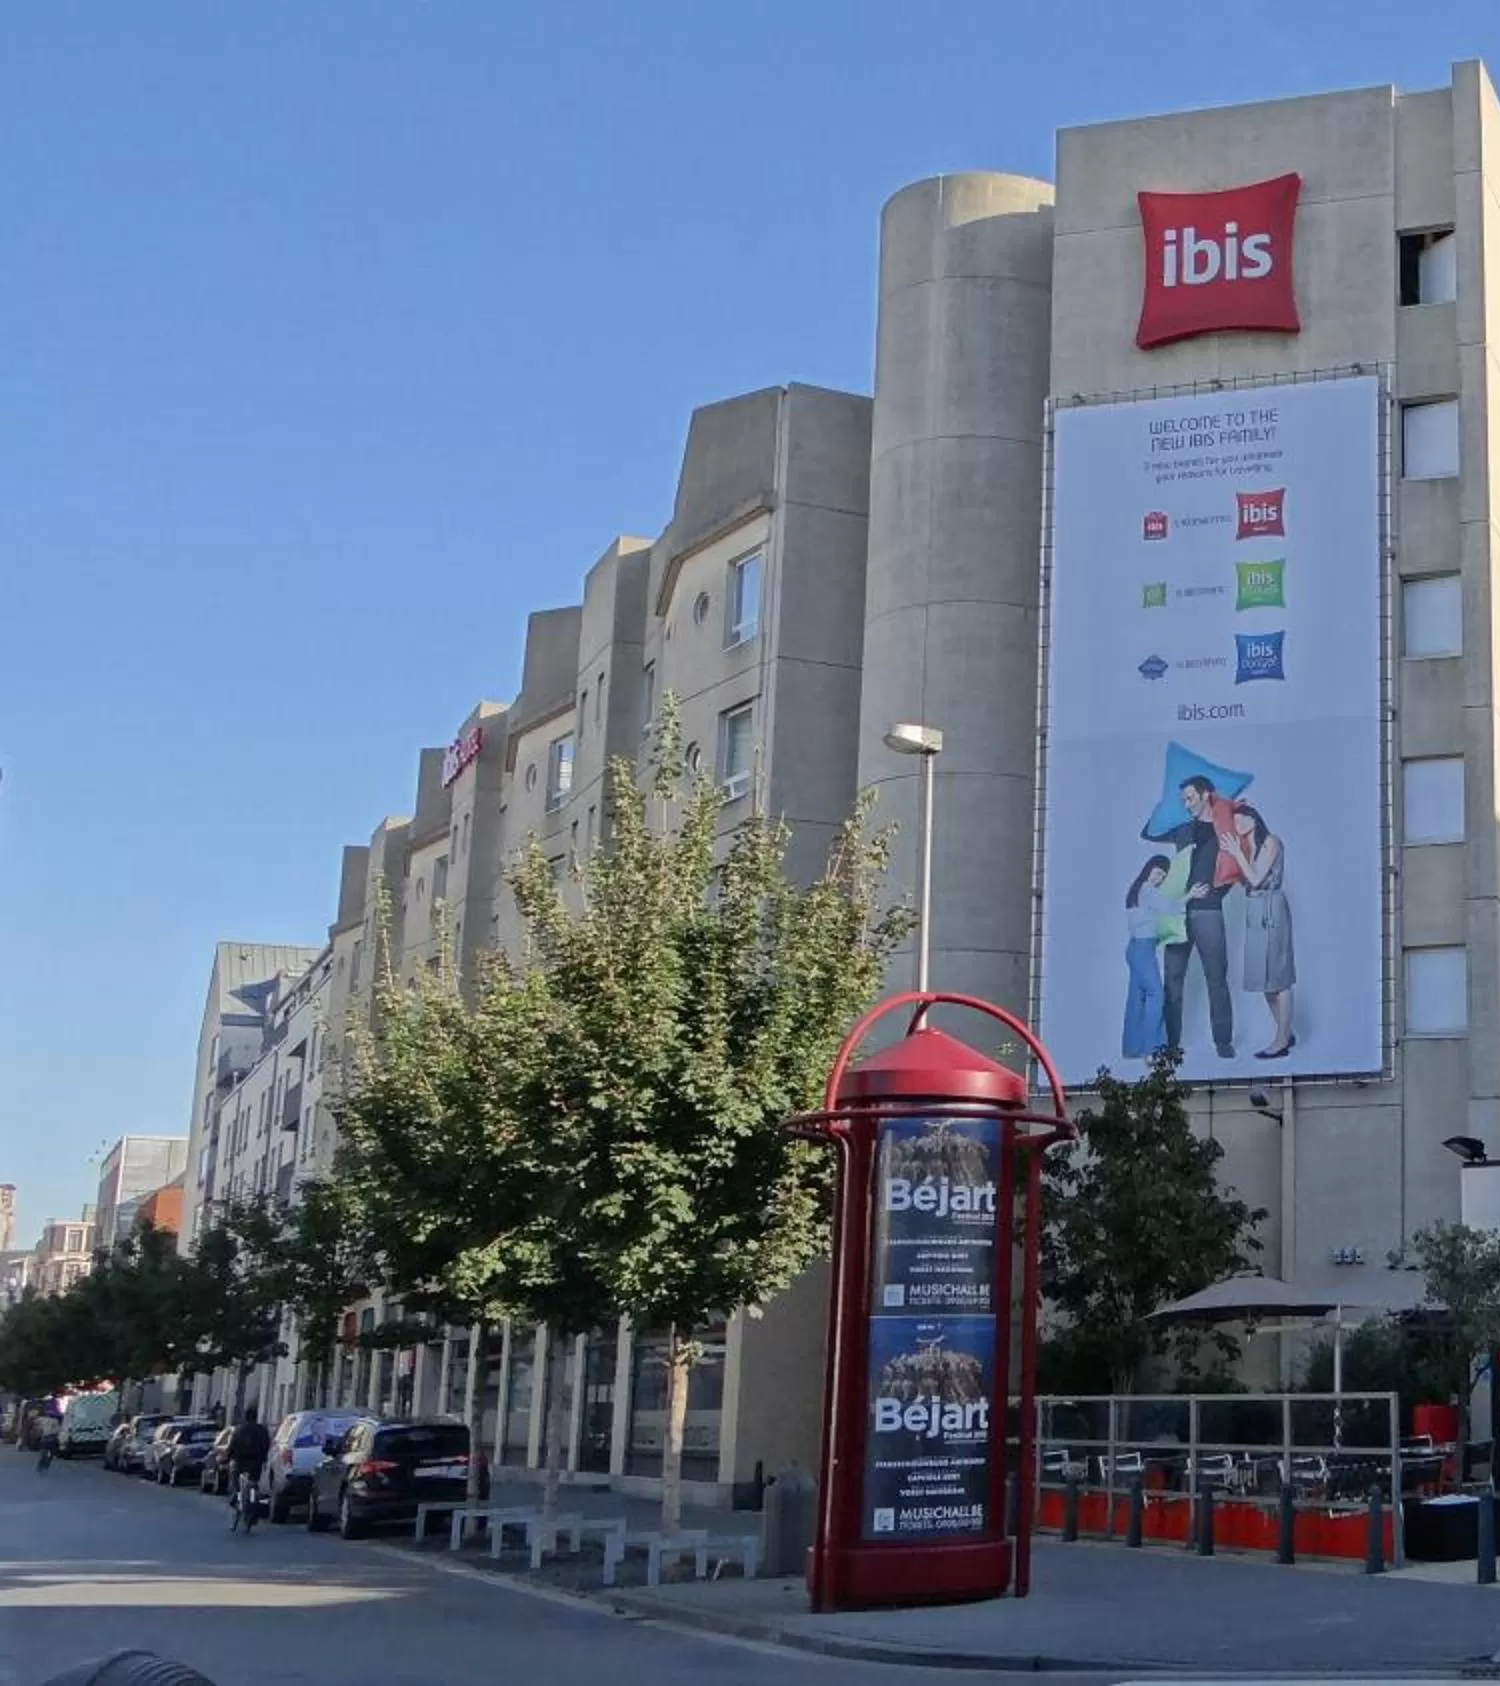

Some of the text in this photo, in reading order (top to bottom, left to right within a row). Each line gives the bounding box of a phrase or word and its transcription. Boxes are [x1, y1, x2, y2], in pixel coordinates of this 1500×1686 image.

[1163, 221, 1273, 288] ibis
[1149, 408, 1280, 434] WELCOME TO THE
[1189, 432, 1215, 448] IBIS
[1243, 503, 1278, 525] ibis
[1247, 570, 1274, 585] ibis
[1247, 642, 1273, 659] ibis
[1177, 703, 1246, 720] ibis.com
[885, 1176, 997, 1217] Béjart
[875, 1395, 989, 1438] Béjart
